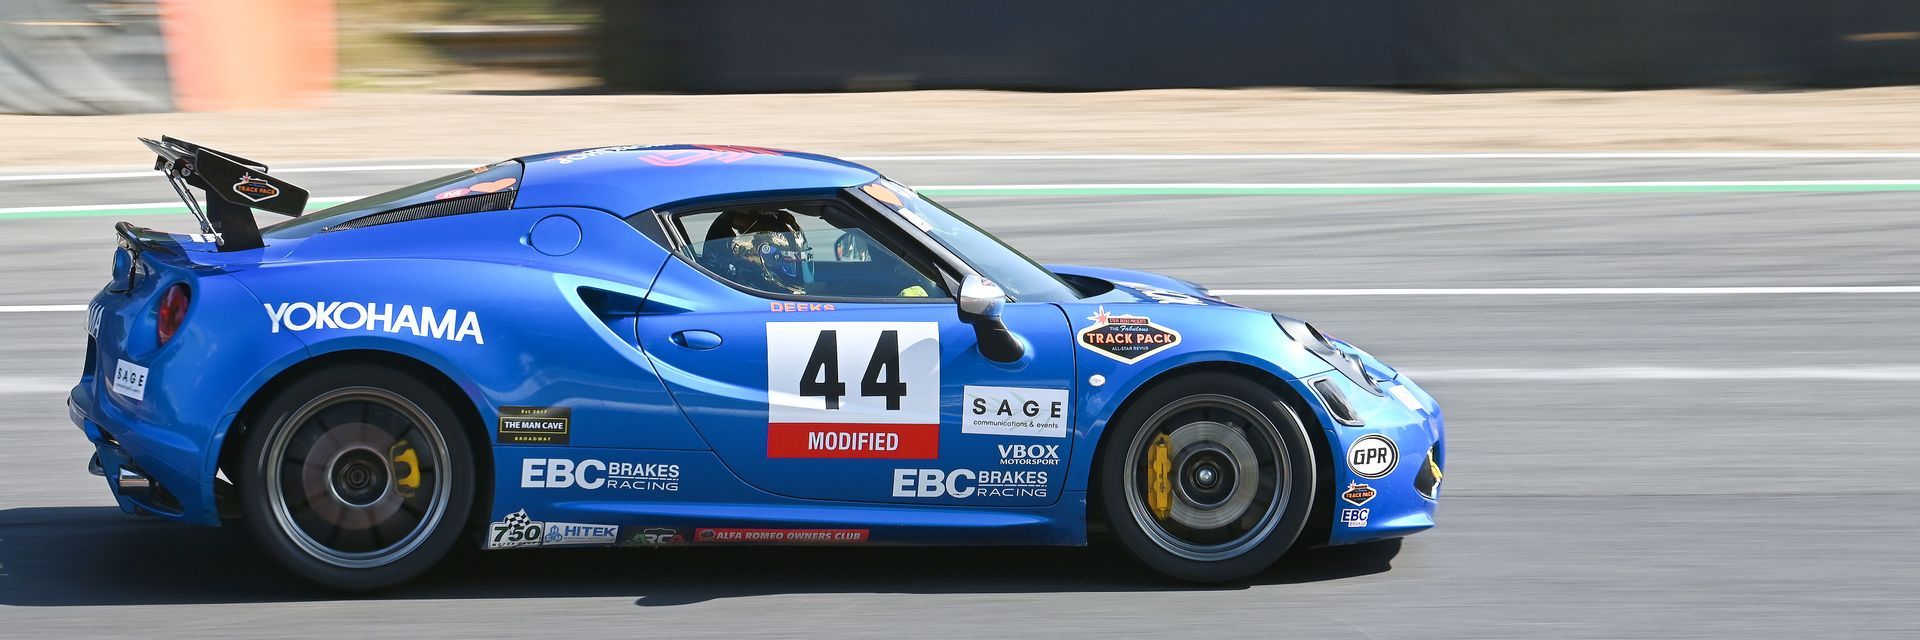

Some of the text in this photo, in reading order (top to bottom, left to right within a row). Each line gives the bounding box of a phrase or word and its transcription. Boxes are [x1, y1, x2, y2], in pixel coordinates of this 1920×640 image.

[770, 301, 836, 312] DEEKS
[263, 301, 485, 345] YOKOHAMA
[1086, 333, 1172, 344] TRACK PACK
[117, 367, 145, 387] SAGE
[799, 329, 907, 411] 44
[972, 397, 1062, 419] SAGE
[504, 421, 564, 430] THE MAN CAVE
[973, 420, 1028, 428] communications
[807, 431, 899, 451] MODIFIED
[997, 444, 1060, 459] VBOX
[1353, 447, 1387, 465] GPR
[521, 458, 680, 490] EBC BRAKES
[607, 479, 679, 492] RACING
[892, 468, 1048, 499] EBC BRAKES
[977, 488, 1047, 497] RACING
[1342, 509, 1368, 521] EBC
[493, 525, 541, 542] 750
[563, 525, 616, 537] HITEK
[716, 531, 861, 540] ALFA ROMEO OWNERS CLUB
